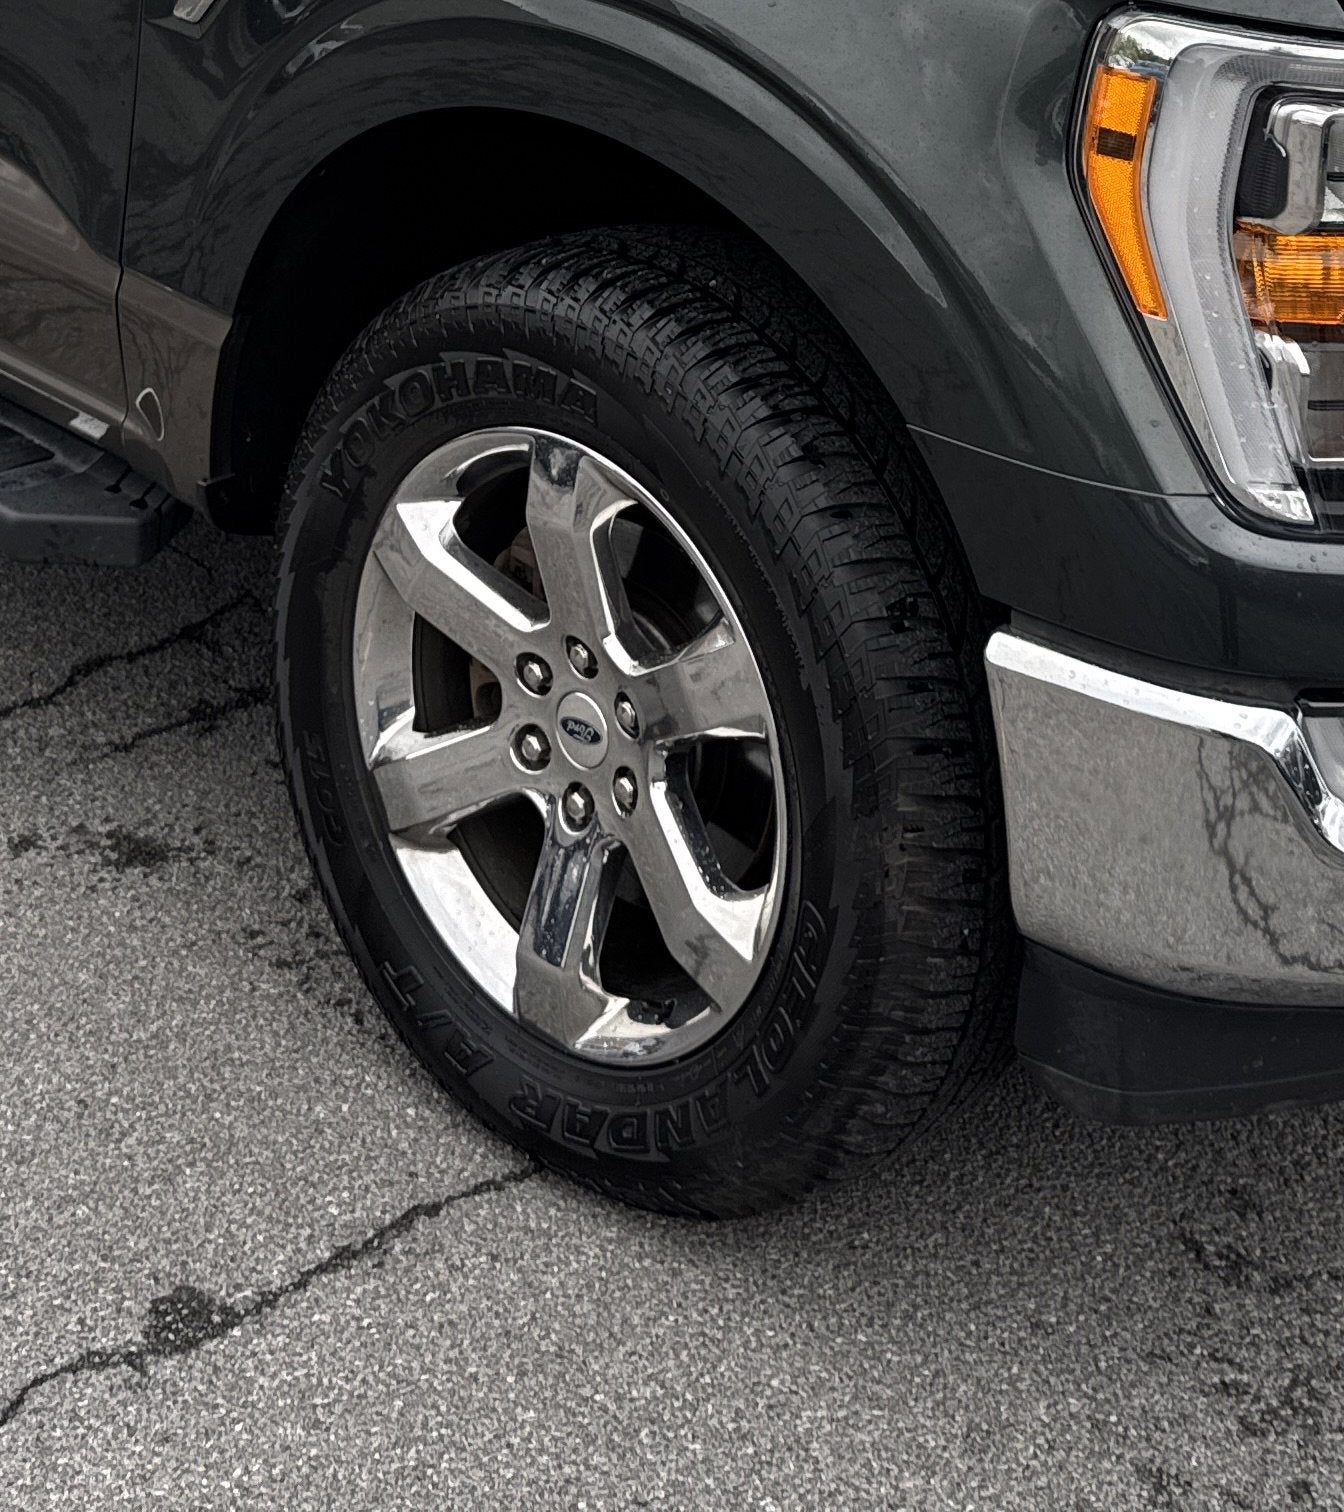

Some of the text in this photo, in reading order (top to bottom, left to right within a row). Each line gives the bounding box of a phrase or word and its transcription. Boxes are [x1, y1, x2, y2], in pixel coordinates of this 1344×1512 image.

[319, 356, 600, 499] YOKOHAMA
[566, 720, 595, 742] Ford
[380, 900, 827, 1154] GEOLANDAR A/T
